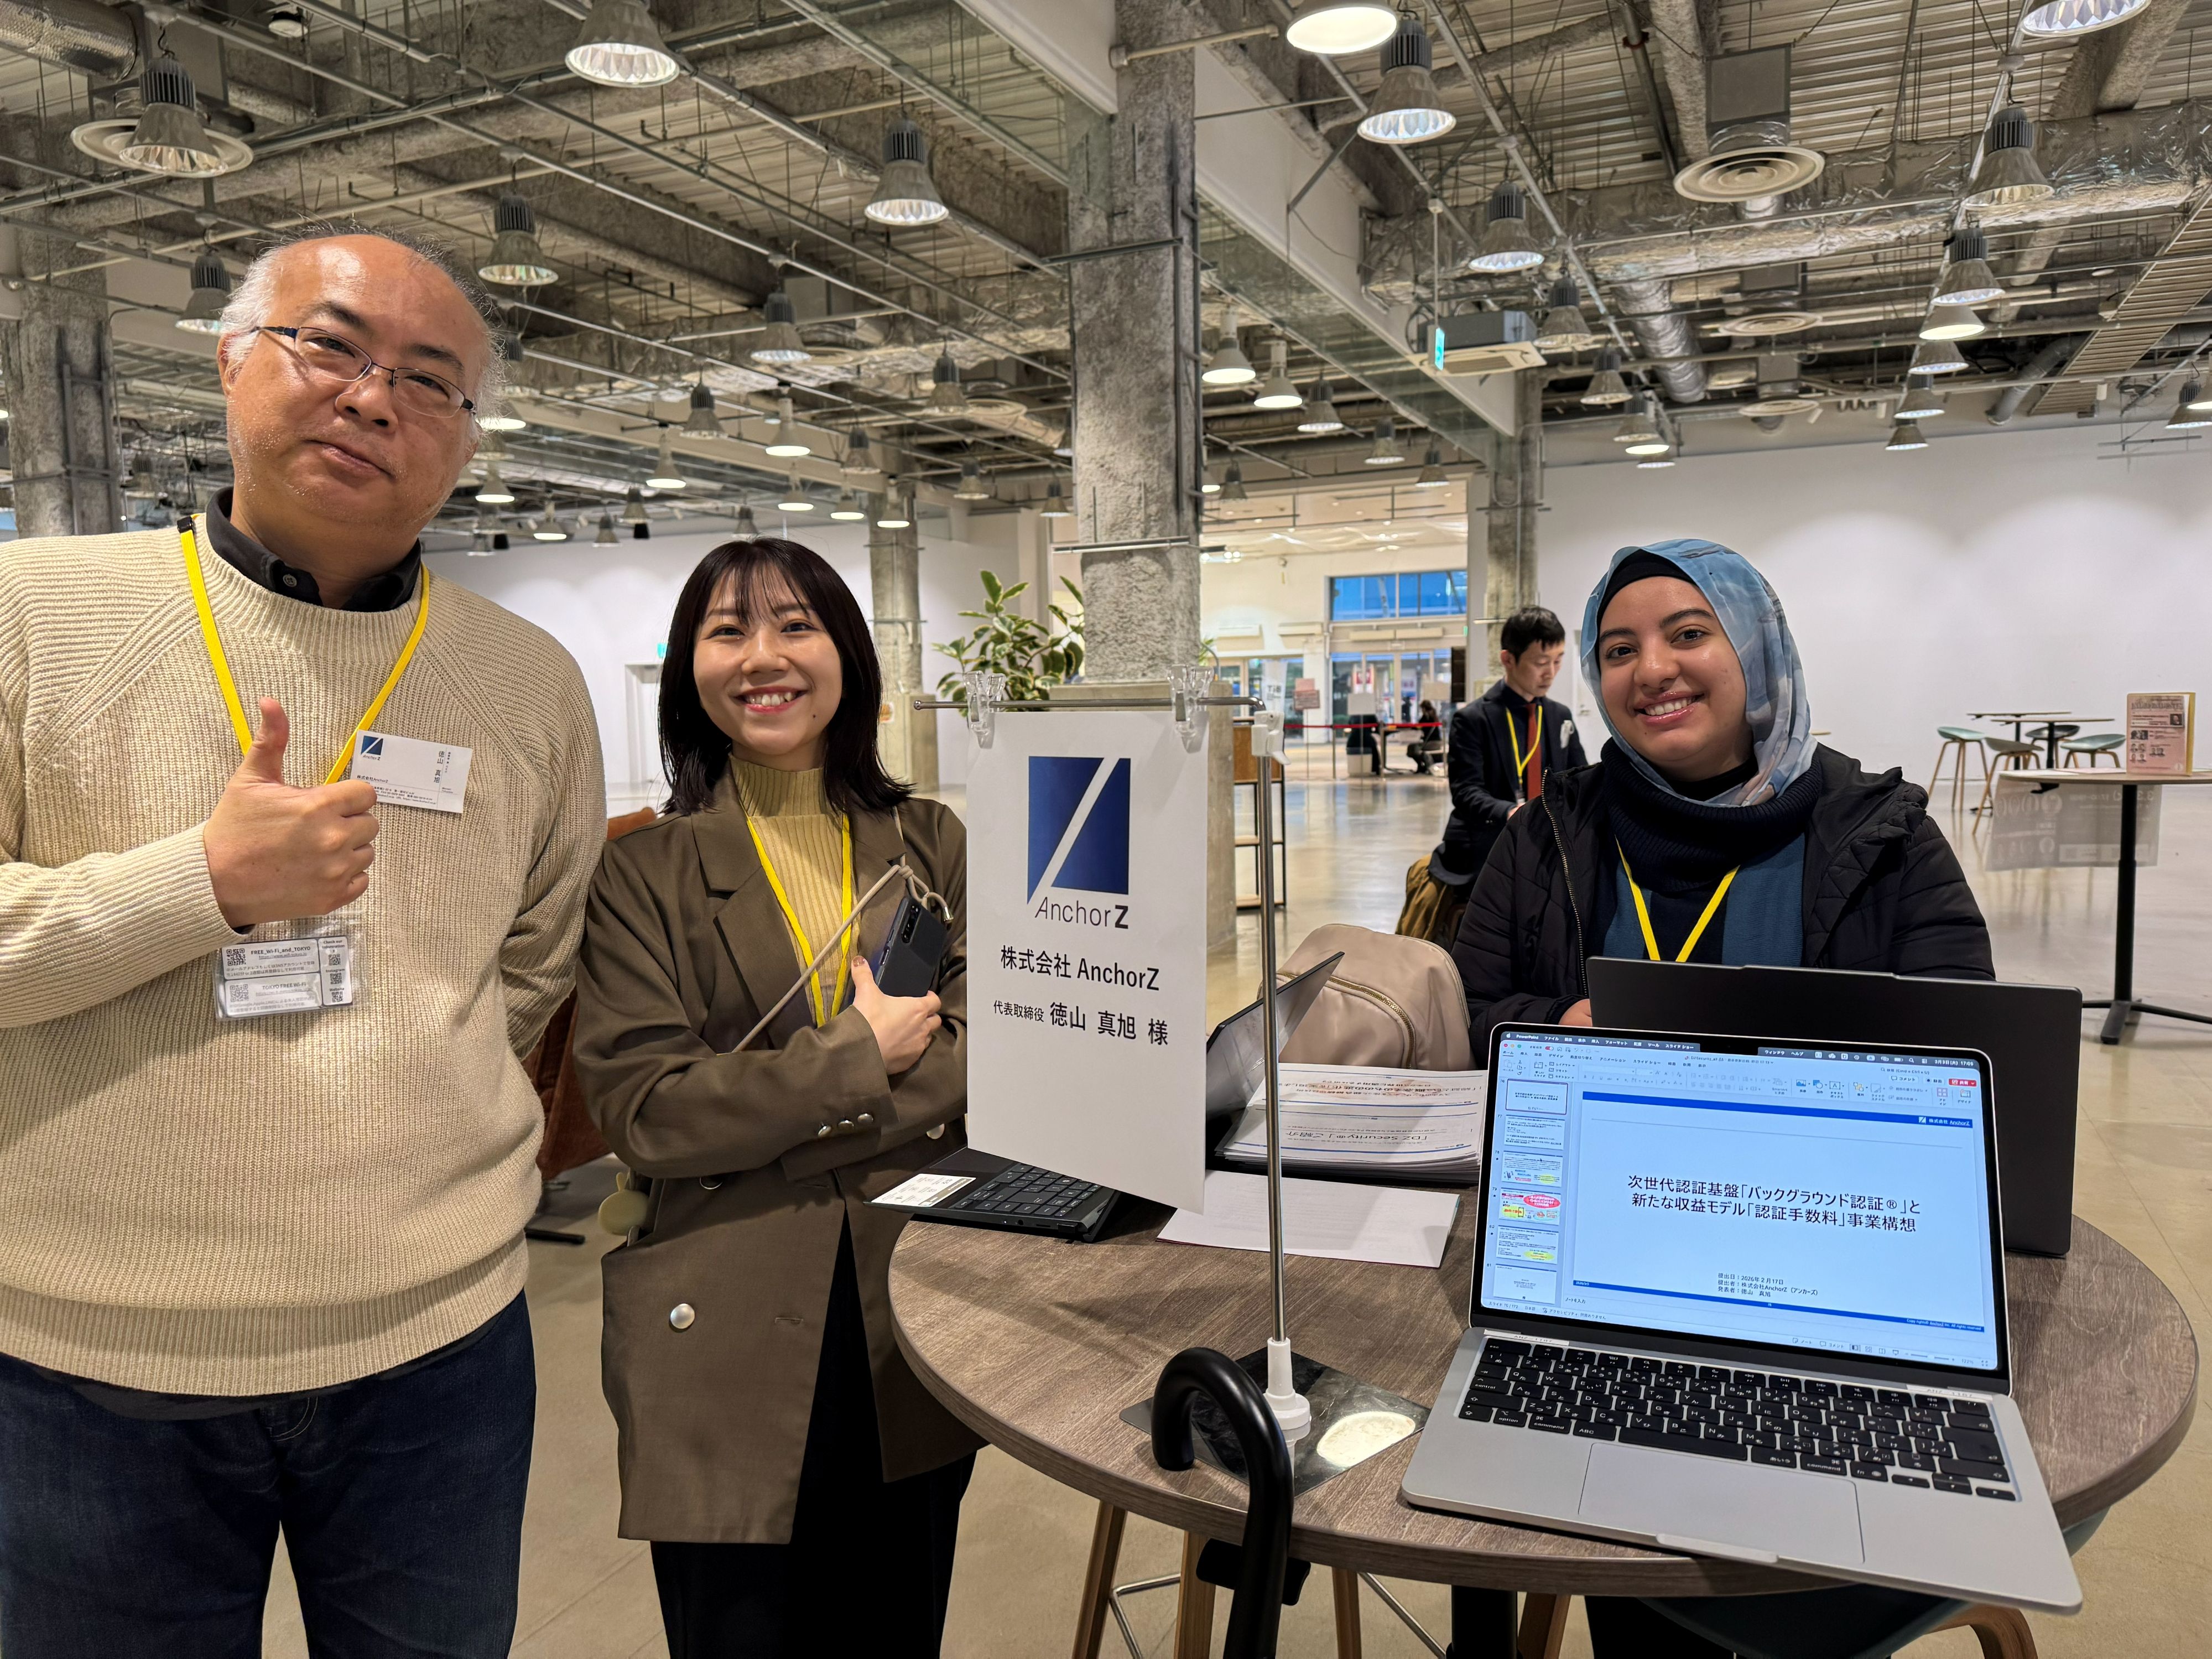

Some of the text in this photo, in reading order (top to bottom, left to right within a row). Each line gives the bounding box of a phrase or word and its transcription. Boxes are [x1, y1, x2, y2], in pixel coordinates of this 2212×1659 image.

[434, 751, 445, 783] 徳山 真旭
[1035, 896, 1129, 929] AnchorZ
[251, 946, 311, 955] FREE_Wi-Fi_and_TOKYO
[1001, 945, 1159, 991] 株式会社 AnchorZ
[993, 1000, 1168, 1046] 代表取締役 徳山 真旭 様
[1632, 1193, 1916, 1232] 新たな収益モデル「認証手数料」事業構想
[1807, 1463, 1841, 1471] command
